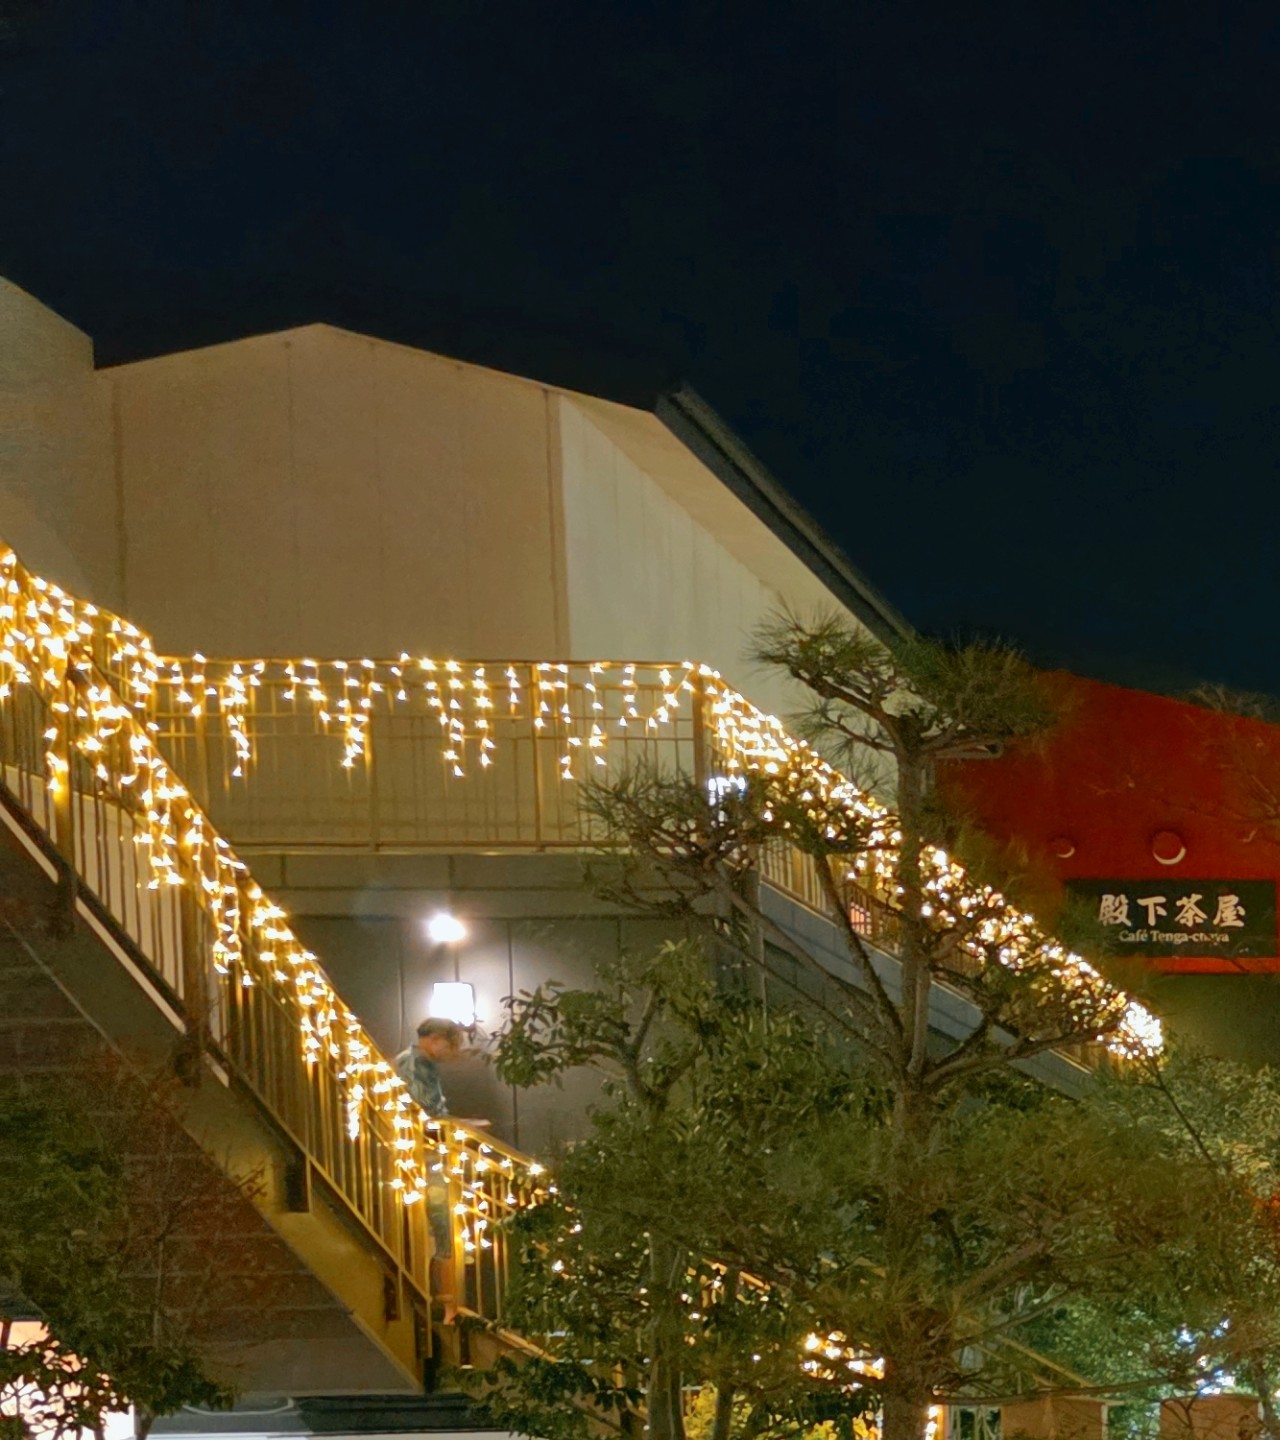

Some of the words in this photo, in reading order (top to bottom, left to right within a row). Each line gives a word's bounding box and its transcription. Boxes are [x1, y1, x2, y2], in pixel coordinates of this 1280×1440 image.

[1099, 894, 1246, 927] 殿下茶屋
[1119, 929, 1148, 942] Café
